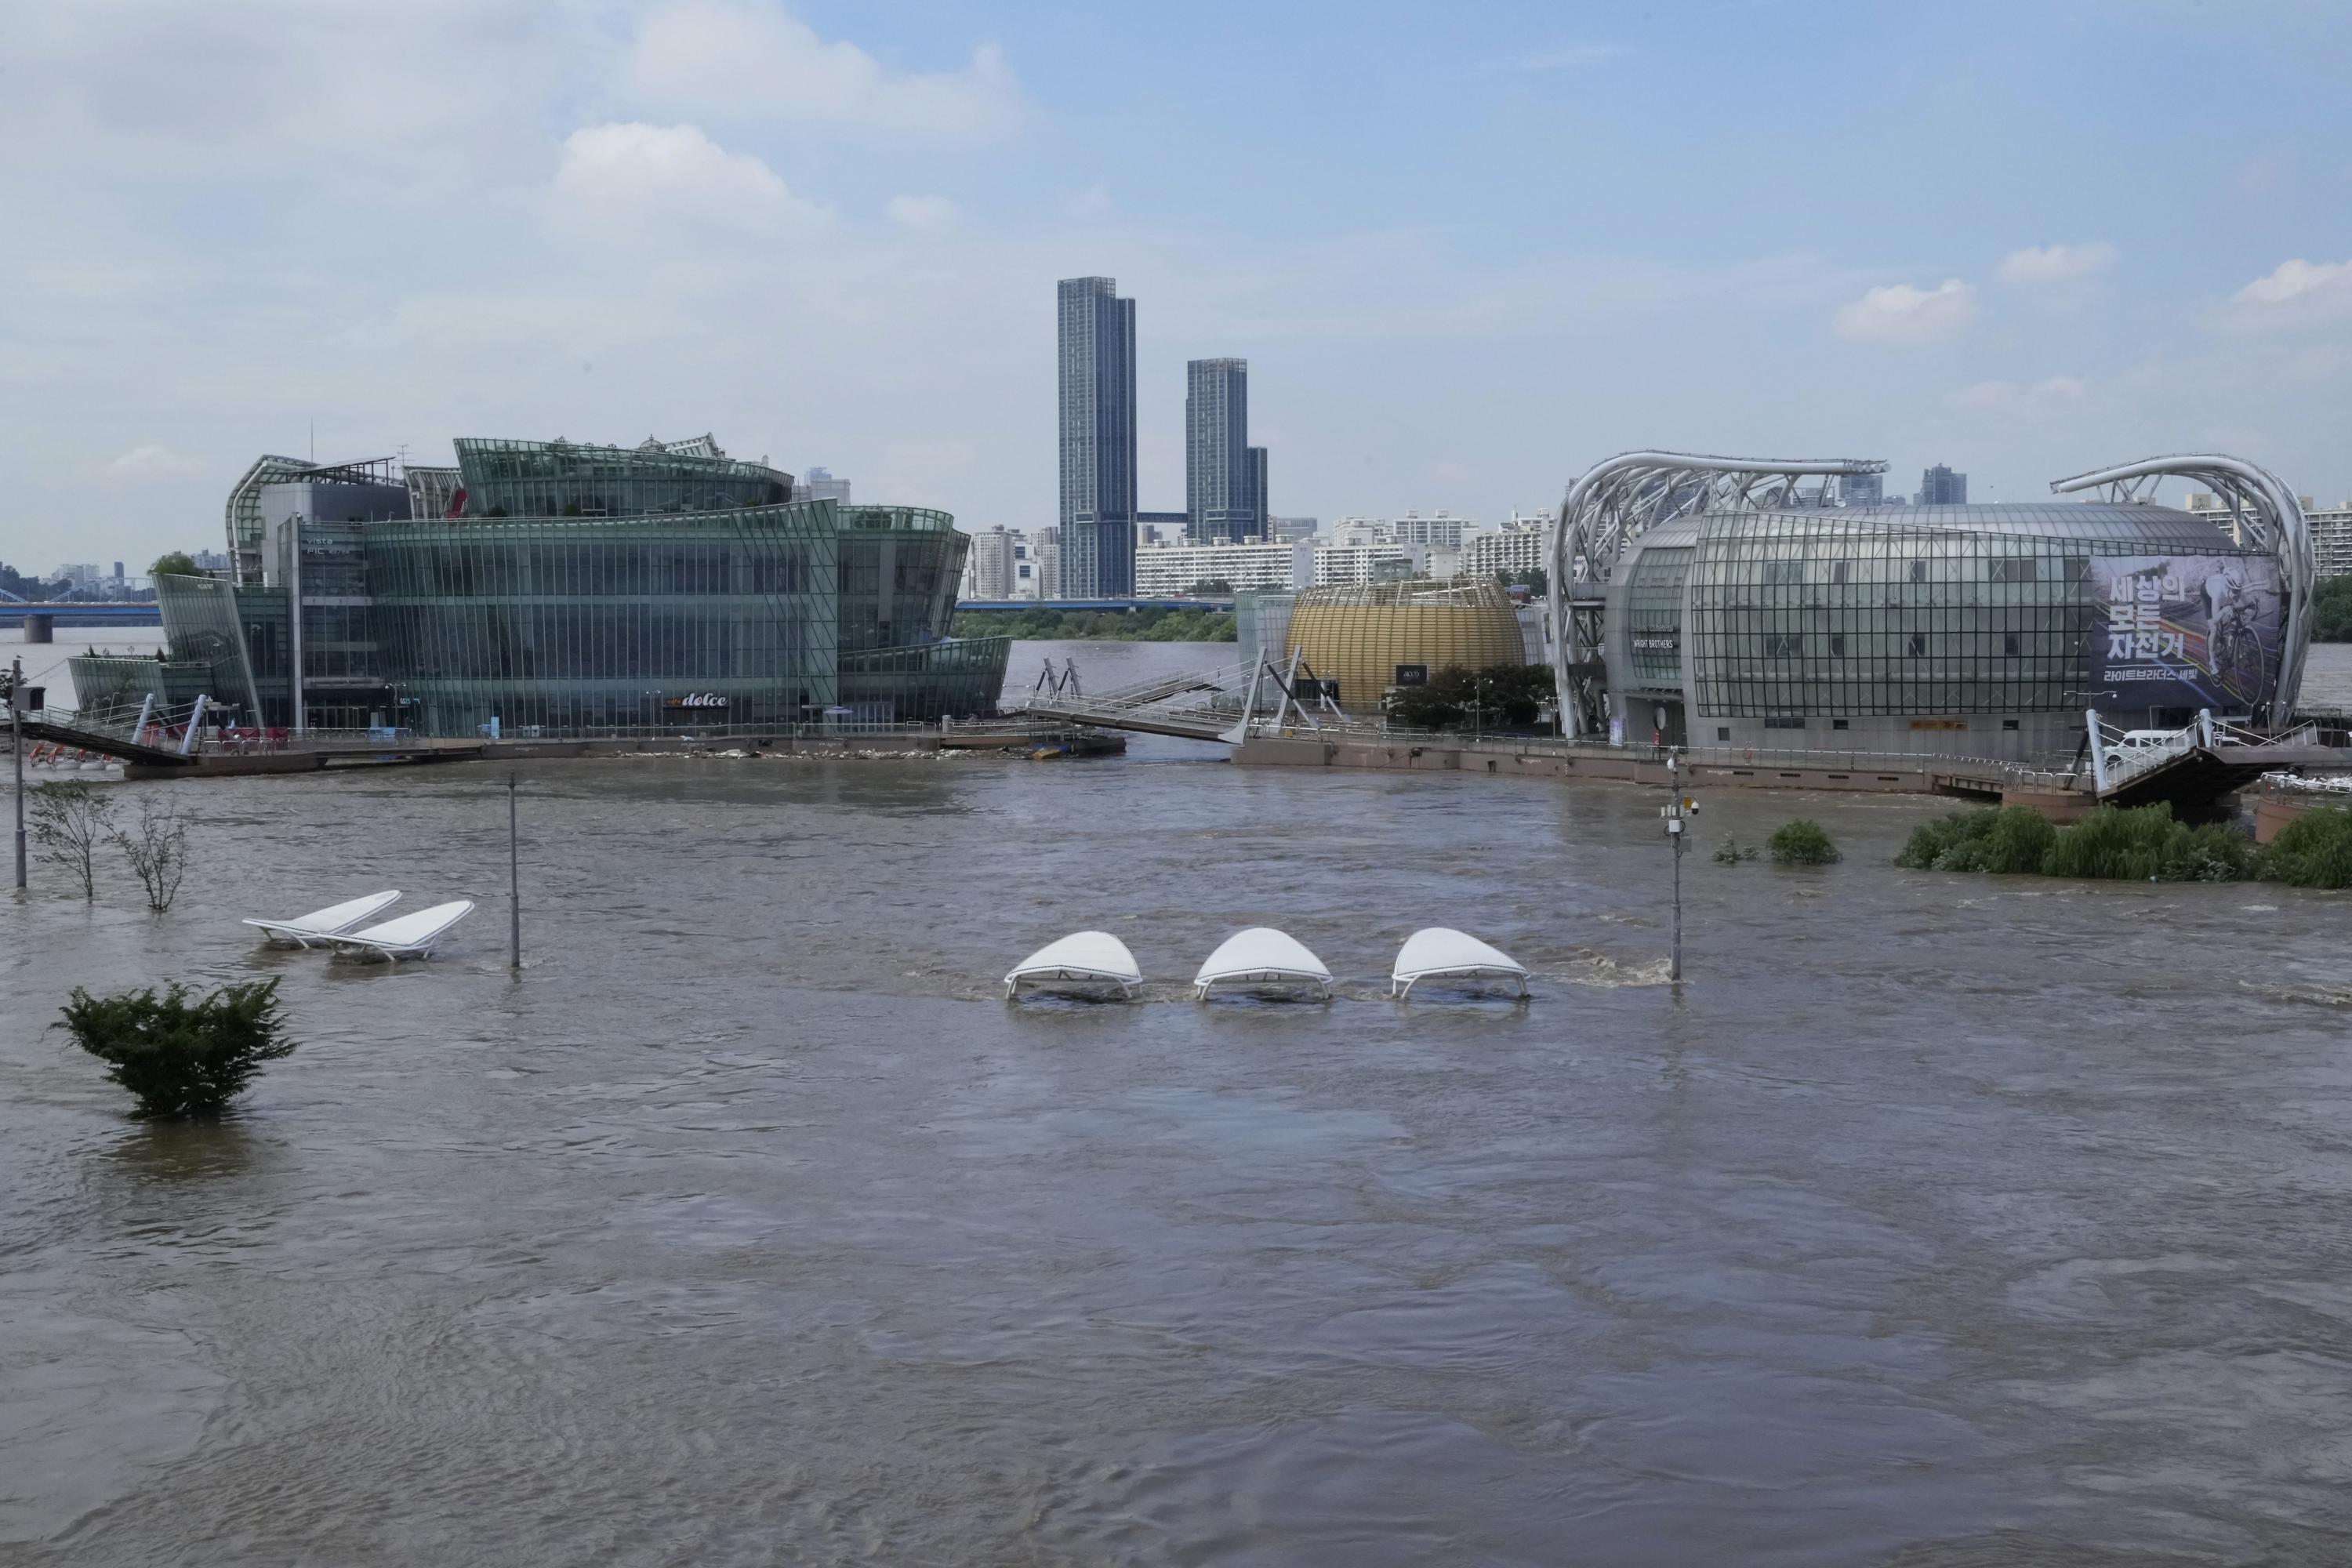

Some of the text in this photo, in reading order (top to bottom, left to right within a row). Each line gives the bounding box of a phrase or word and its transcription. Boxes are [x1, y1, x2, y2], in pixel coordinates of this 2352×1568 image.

[2109, 575, 2185, 602] 세상의
[2108, 604, 2161, 631] 모든
[1634, 639, 1673, 648] WRIGHT BROTHERS
[2107, 632, 2184, 659] 자전거
[2103, 668, 2198, 682] 라이트브라더스 세빛
[682, 692, 728, 706] dolce
